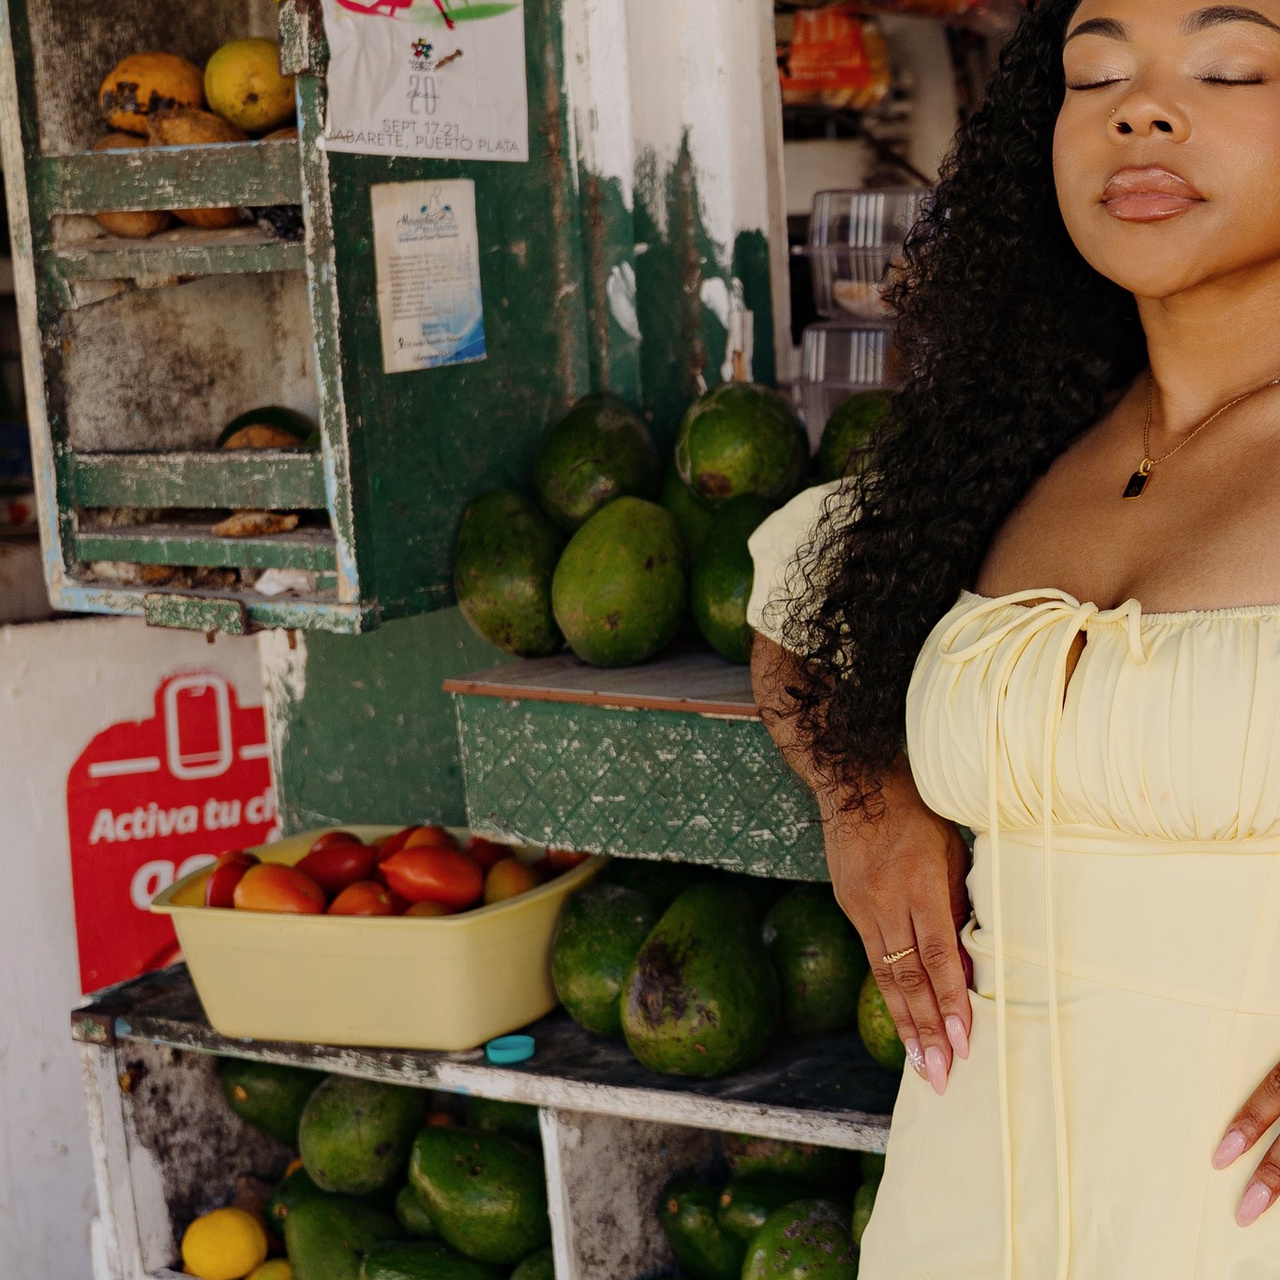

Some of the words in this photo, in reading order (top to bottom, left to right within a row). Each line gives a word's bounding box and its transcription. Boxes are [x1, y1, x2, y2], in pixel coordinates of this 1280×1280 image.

[415, 135, 474, 152] PUERTO
[478, 138, 521, 153] PLATA
[88, 802, 199, 845] Activa
[203, 798, 242, 830] tu
